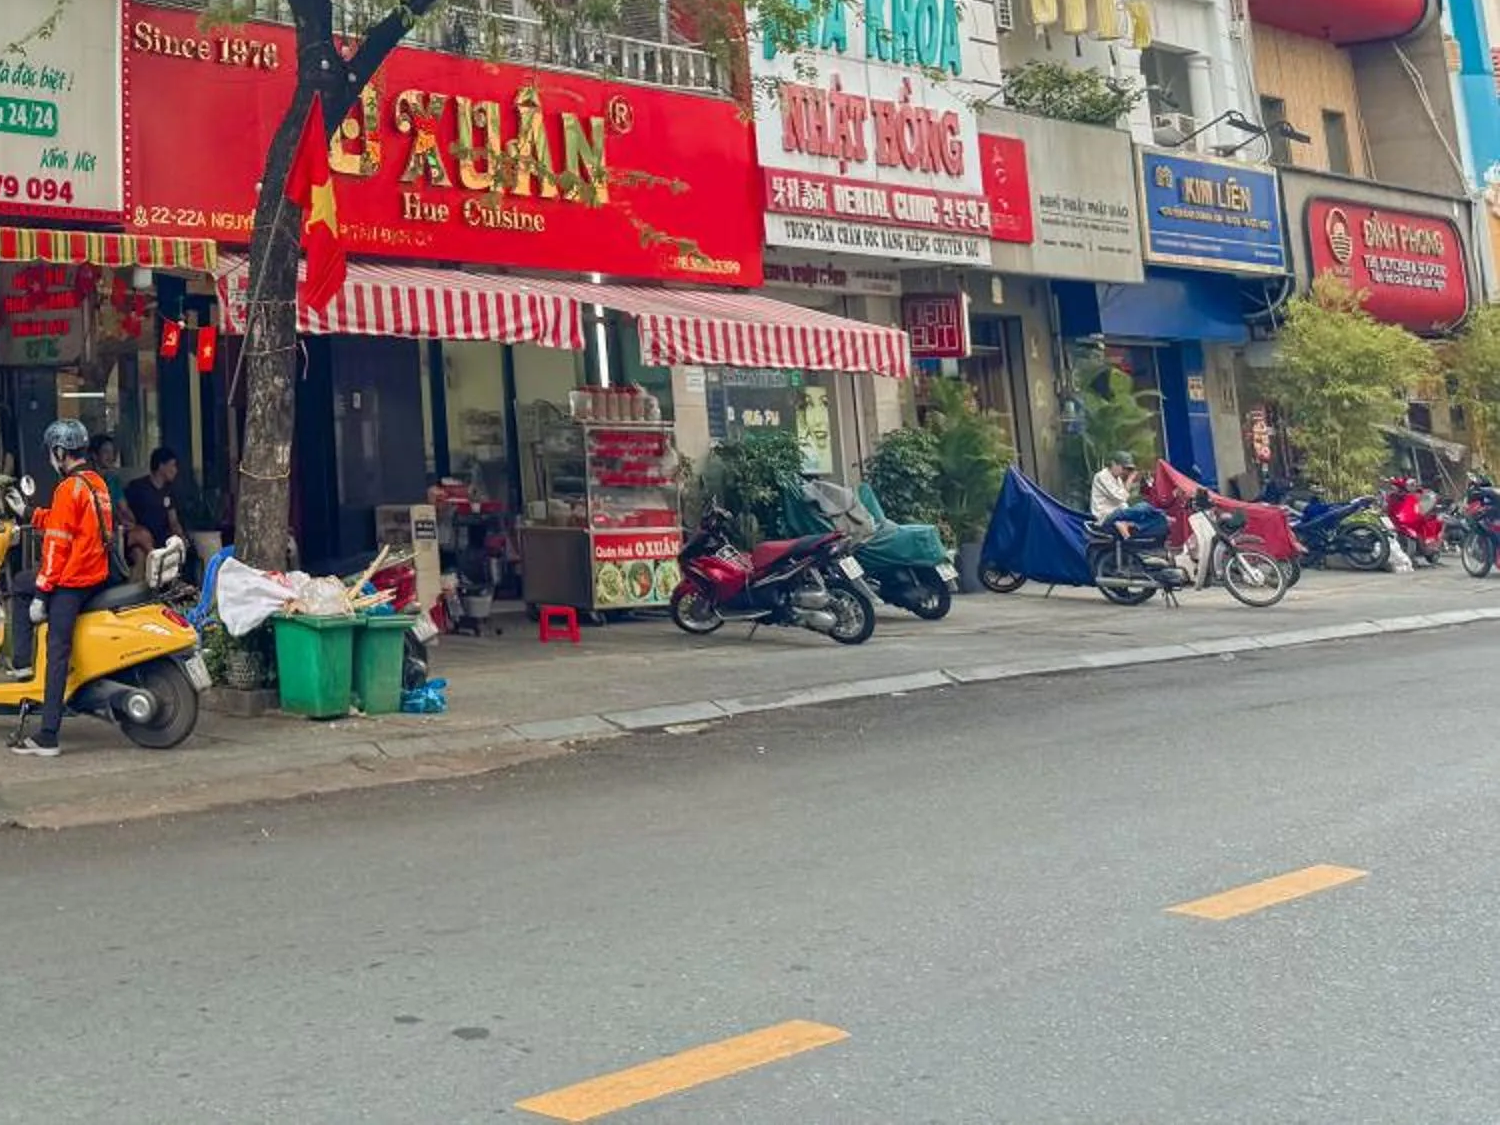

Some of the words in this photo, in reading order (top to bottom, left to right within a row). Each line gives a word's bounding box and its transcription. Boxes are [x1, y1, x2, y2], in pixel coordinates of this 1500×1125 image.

[133, 20, 212, 60] Since
[9, 103, 55, 130] 24/24
[871, 77, 964, 176] HỒNG
[395, 85, 610, 205] XUÂN
[26, 177, 73, 204] 094
[831, 182, 892, 219] DENTAL
[892, 191, 940, 224] CLINIC
[149, 206, 206, 226] 22-22A
[403, 192, 449, 223] Hue
[463, 198, 545, 231] Cuisine
[1400, 224, 1445, 256] PHONG
